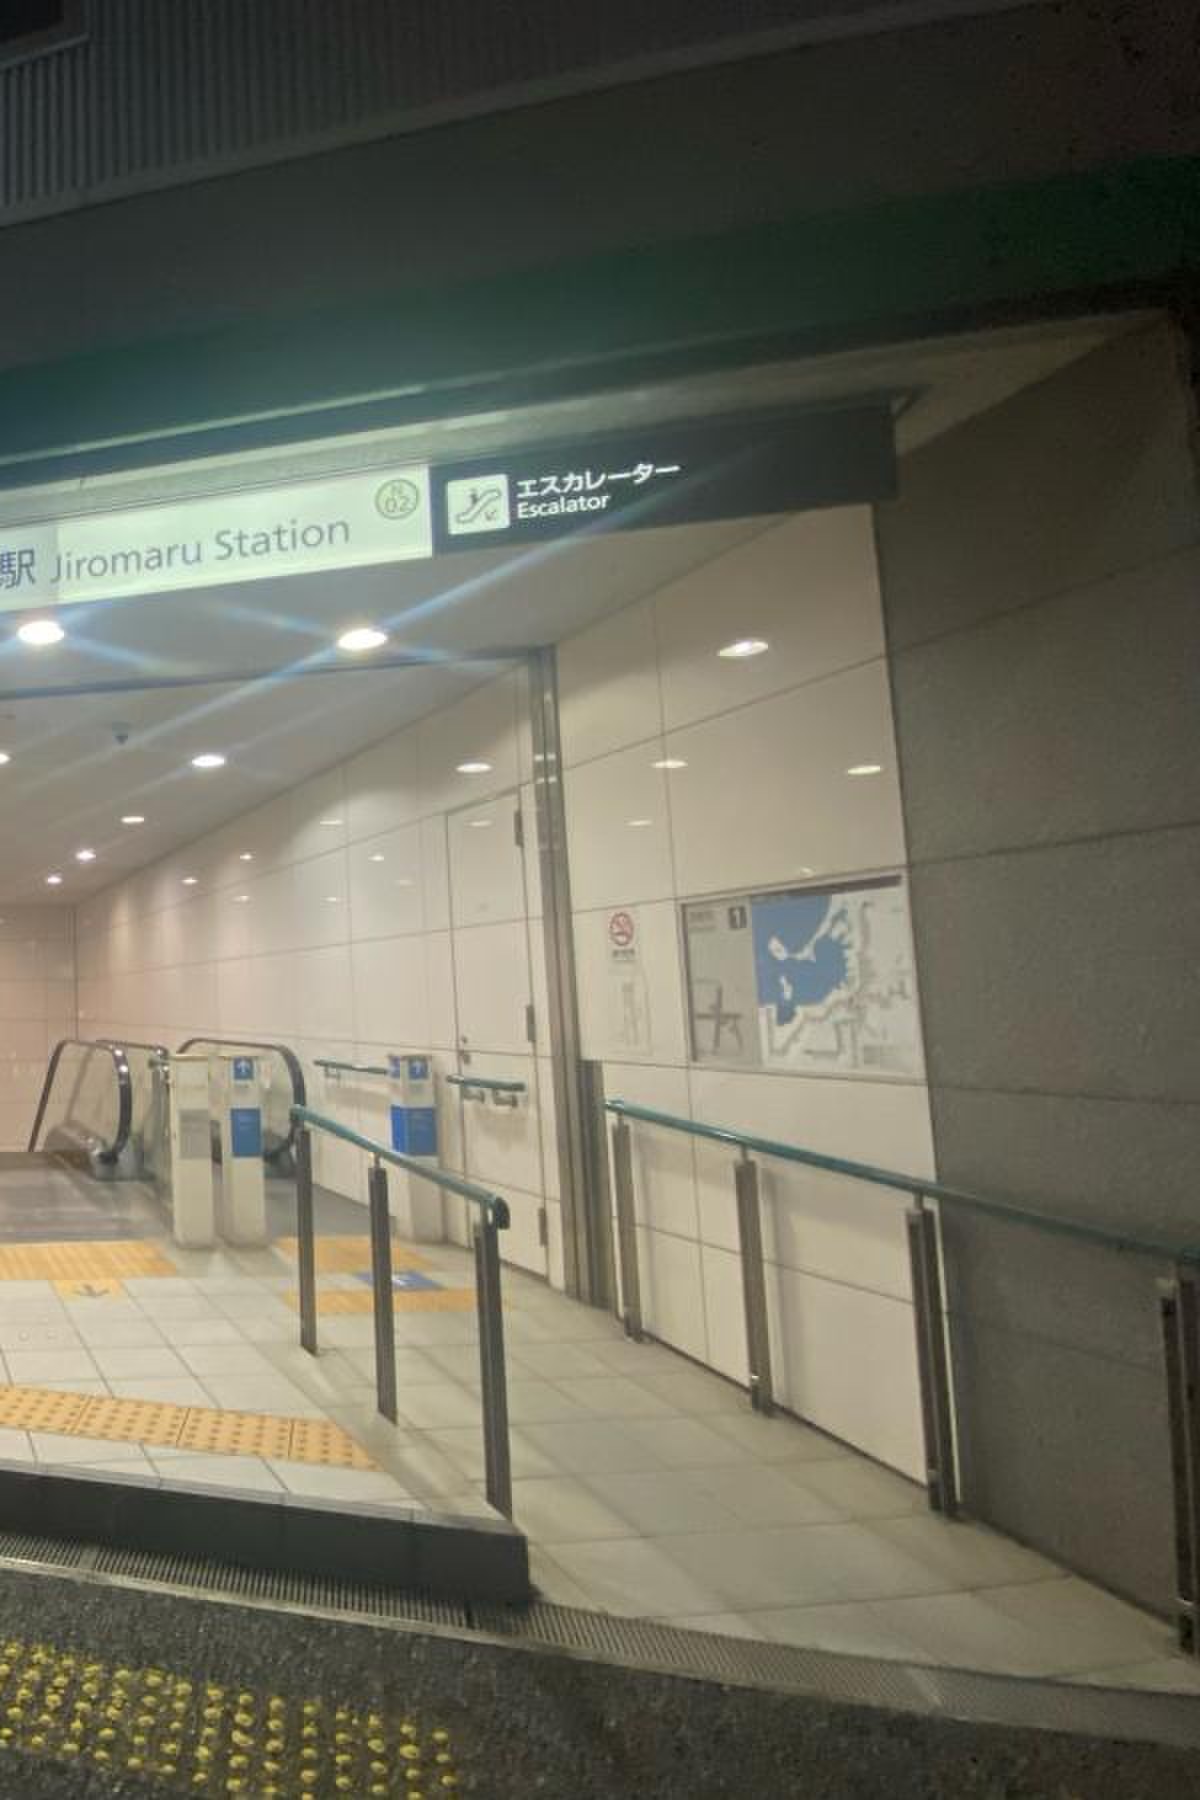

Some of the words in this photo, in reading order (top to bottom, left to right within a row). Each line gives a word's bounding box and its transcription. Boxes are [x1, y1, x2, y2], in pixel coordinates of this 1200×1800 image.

[516, 463, 681, 499] エスカレーター
[384, 496, 416, 513] 02
[516, 495, 611, 519] Escalator
[50, 541, 202, 584] Jiromaru
[214, 519, 351, 562] Station
